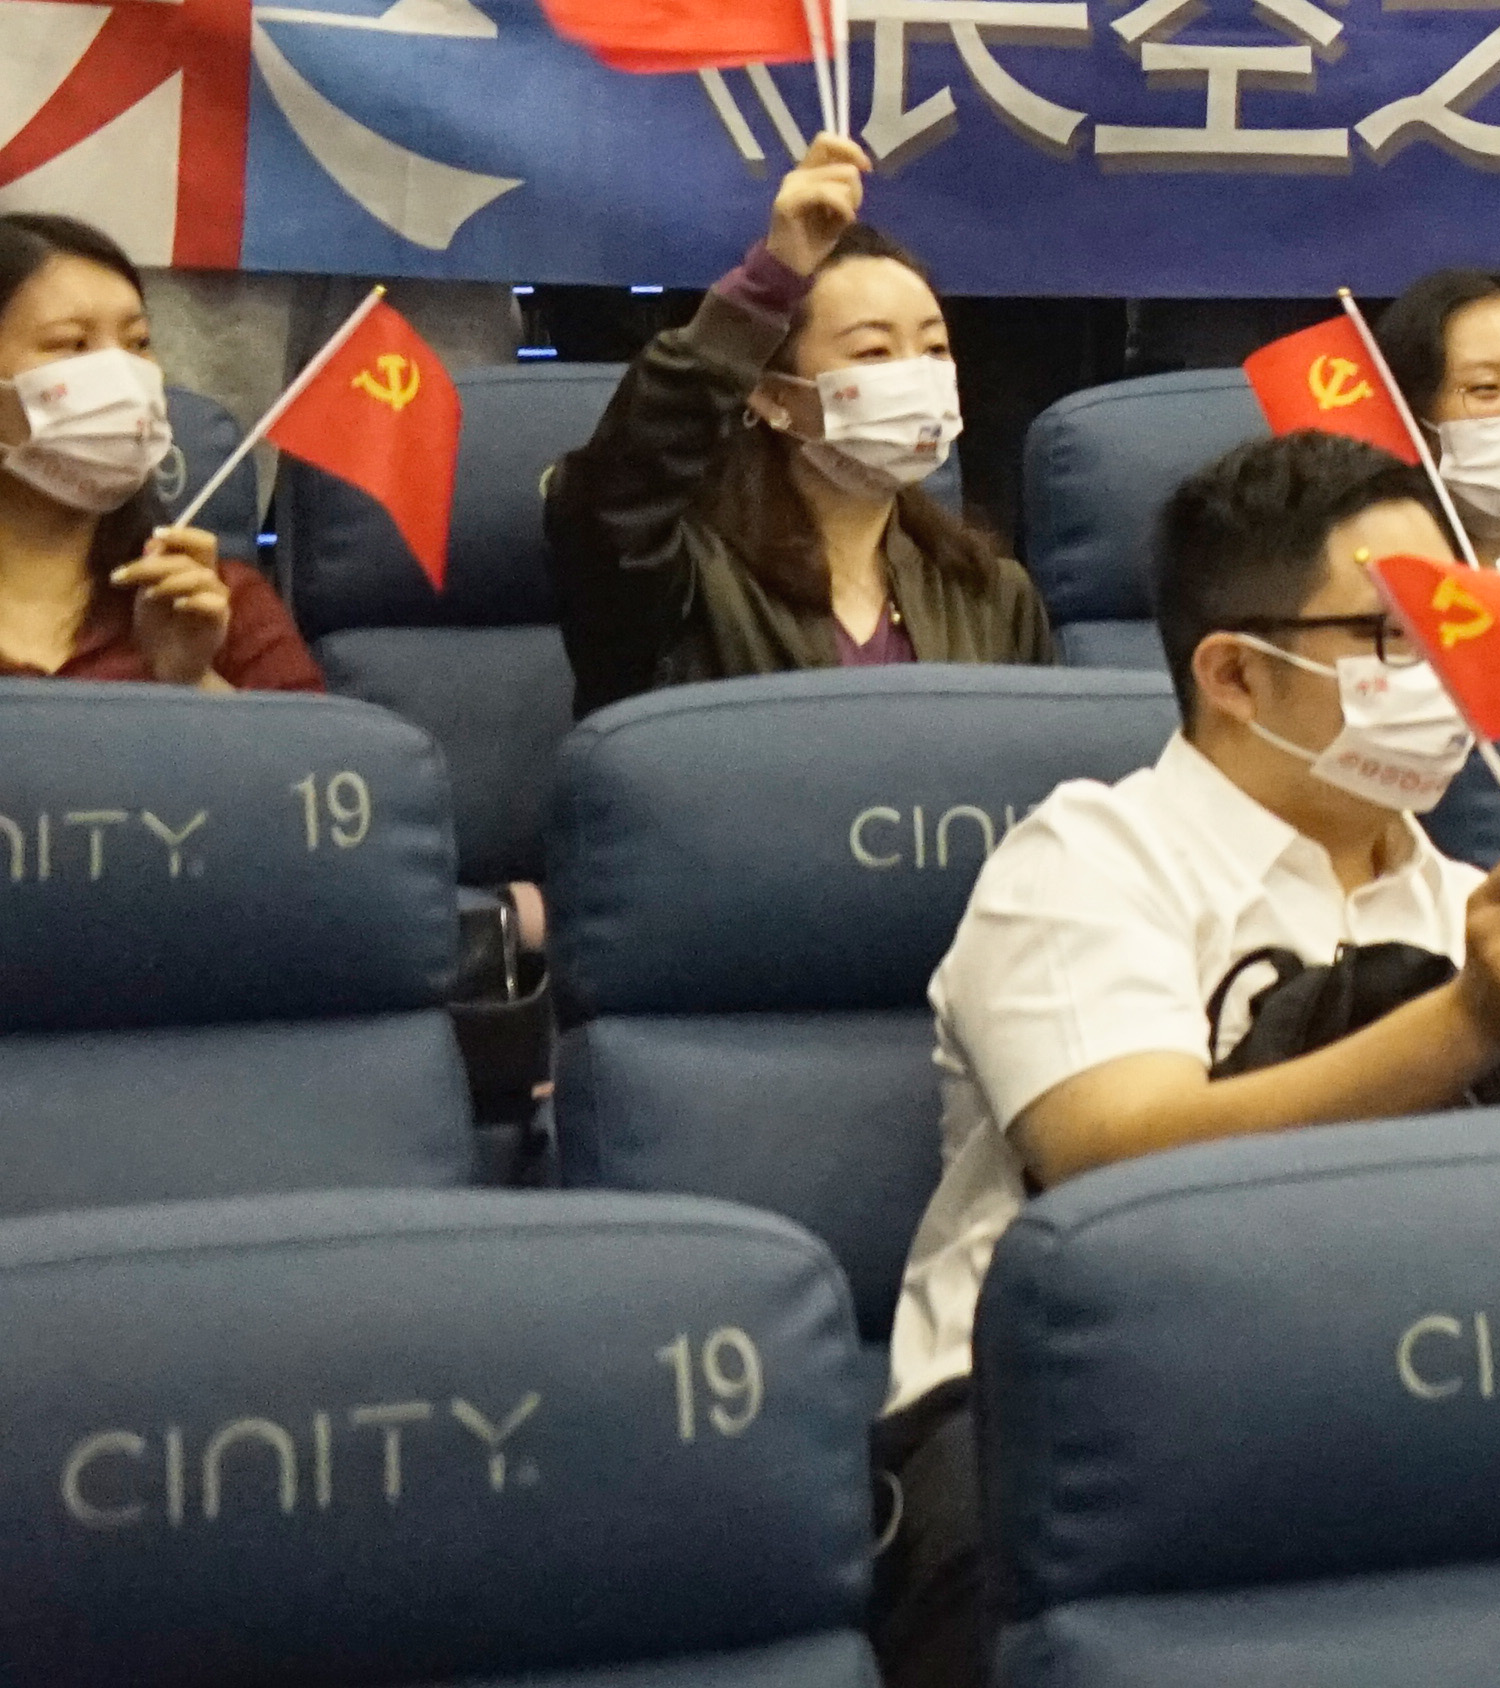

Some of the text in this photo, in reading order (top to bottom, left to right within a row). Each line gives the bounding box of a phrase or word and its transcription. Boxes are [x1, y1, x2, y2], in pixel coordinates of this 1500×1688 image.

[293, 770, 373, 851] 19
[61, 1325, 765, 1527] CINITY 19
